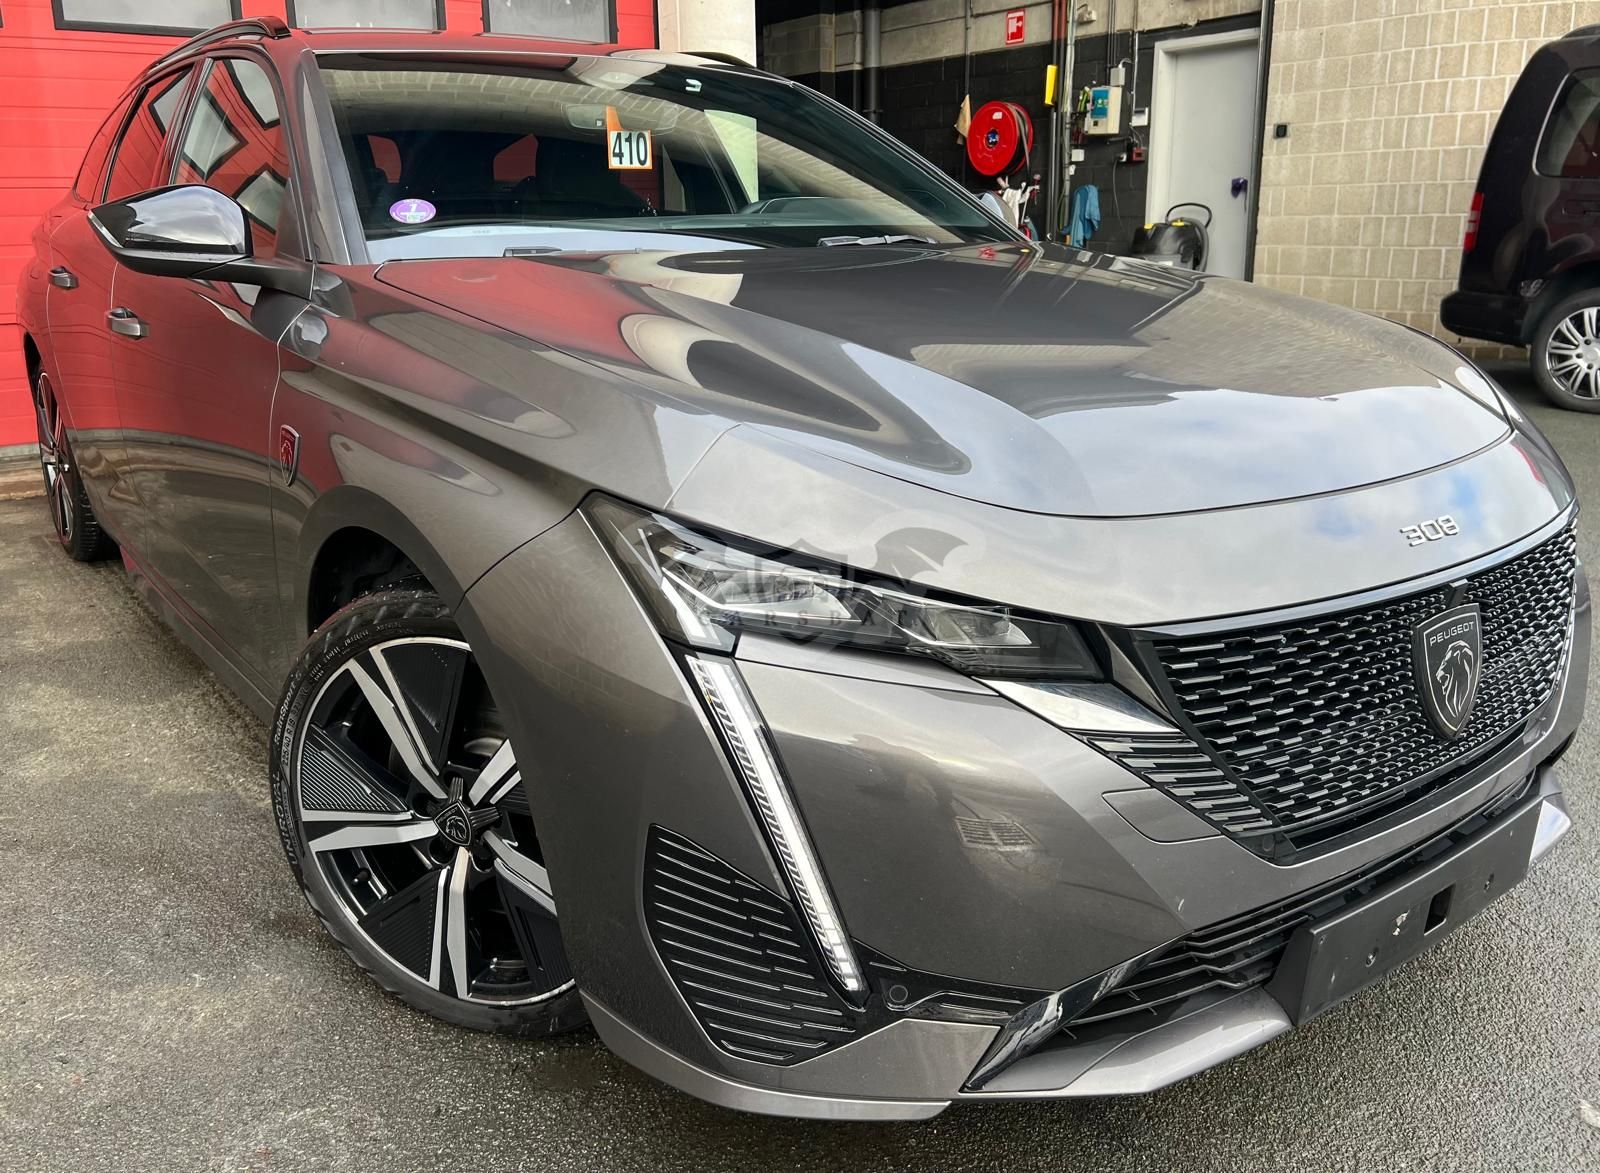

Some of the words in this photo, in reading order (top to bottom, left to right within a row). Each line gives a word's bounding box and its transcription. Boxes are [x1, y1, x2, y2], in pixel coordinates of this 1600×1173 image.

[612, 132, 648, 166] 410
[1400, 515, 1460, 546] 308
[1429, 621, 1474, 646] PEUGEOT
[274, 680, 297, 745] RainSport
[272, 771, 298, 865] UNIROYAL
